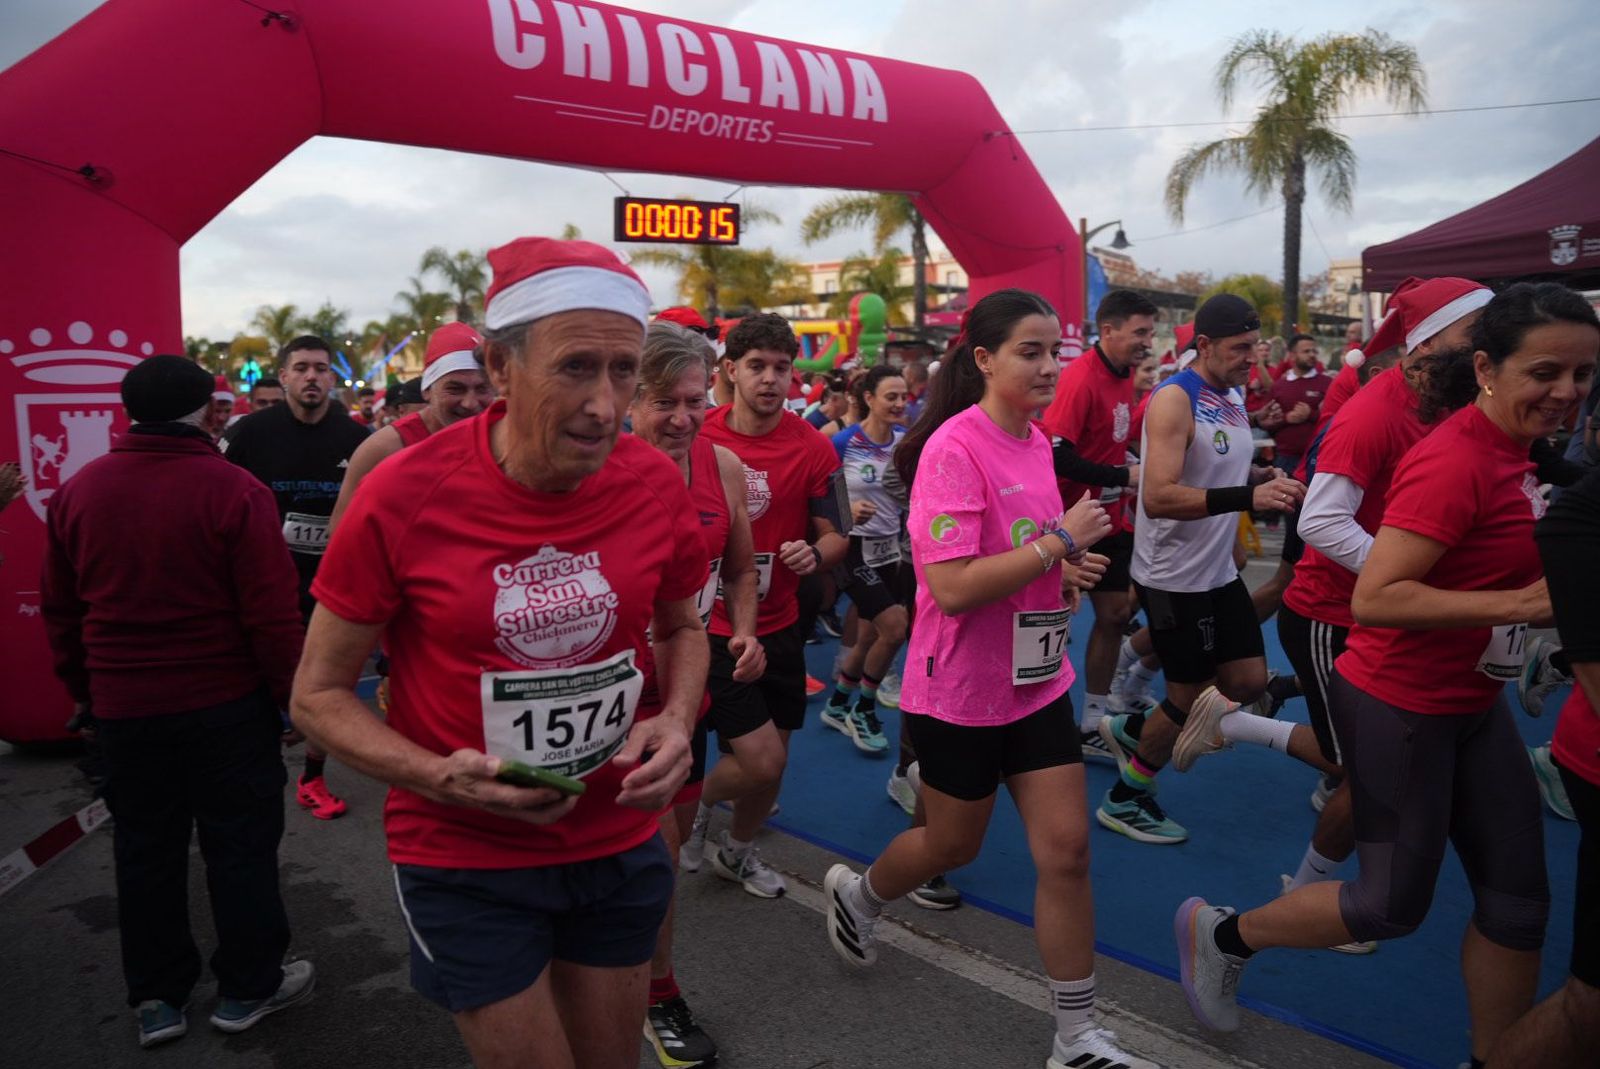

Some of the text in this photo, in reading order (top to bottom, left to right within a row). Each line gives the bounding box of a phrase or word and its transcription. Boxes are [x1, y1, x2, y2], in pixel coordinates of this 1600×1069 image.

[488, 0, 889, 122] CHICLANA
[649, 105, 774, 143] DEPORTES
[293, 526, 329, 541] 117
[493, 551, 602, 588] Carrera
[526, 580, 586, 608] San
[497, 592, 620, 638] Silvestre
[522, 619, 600, 644] Chiclanera
[1039, 627, 1069, 657] 17
[504, 681, 541, 693] CARRERA
[541, 680, 558, 691] SAN
[513, 690, 626, 751] 1574
[541, 749, 571, 762] JOSE
